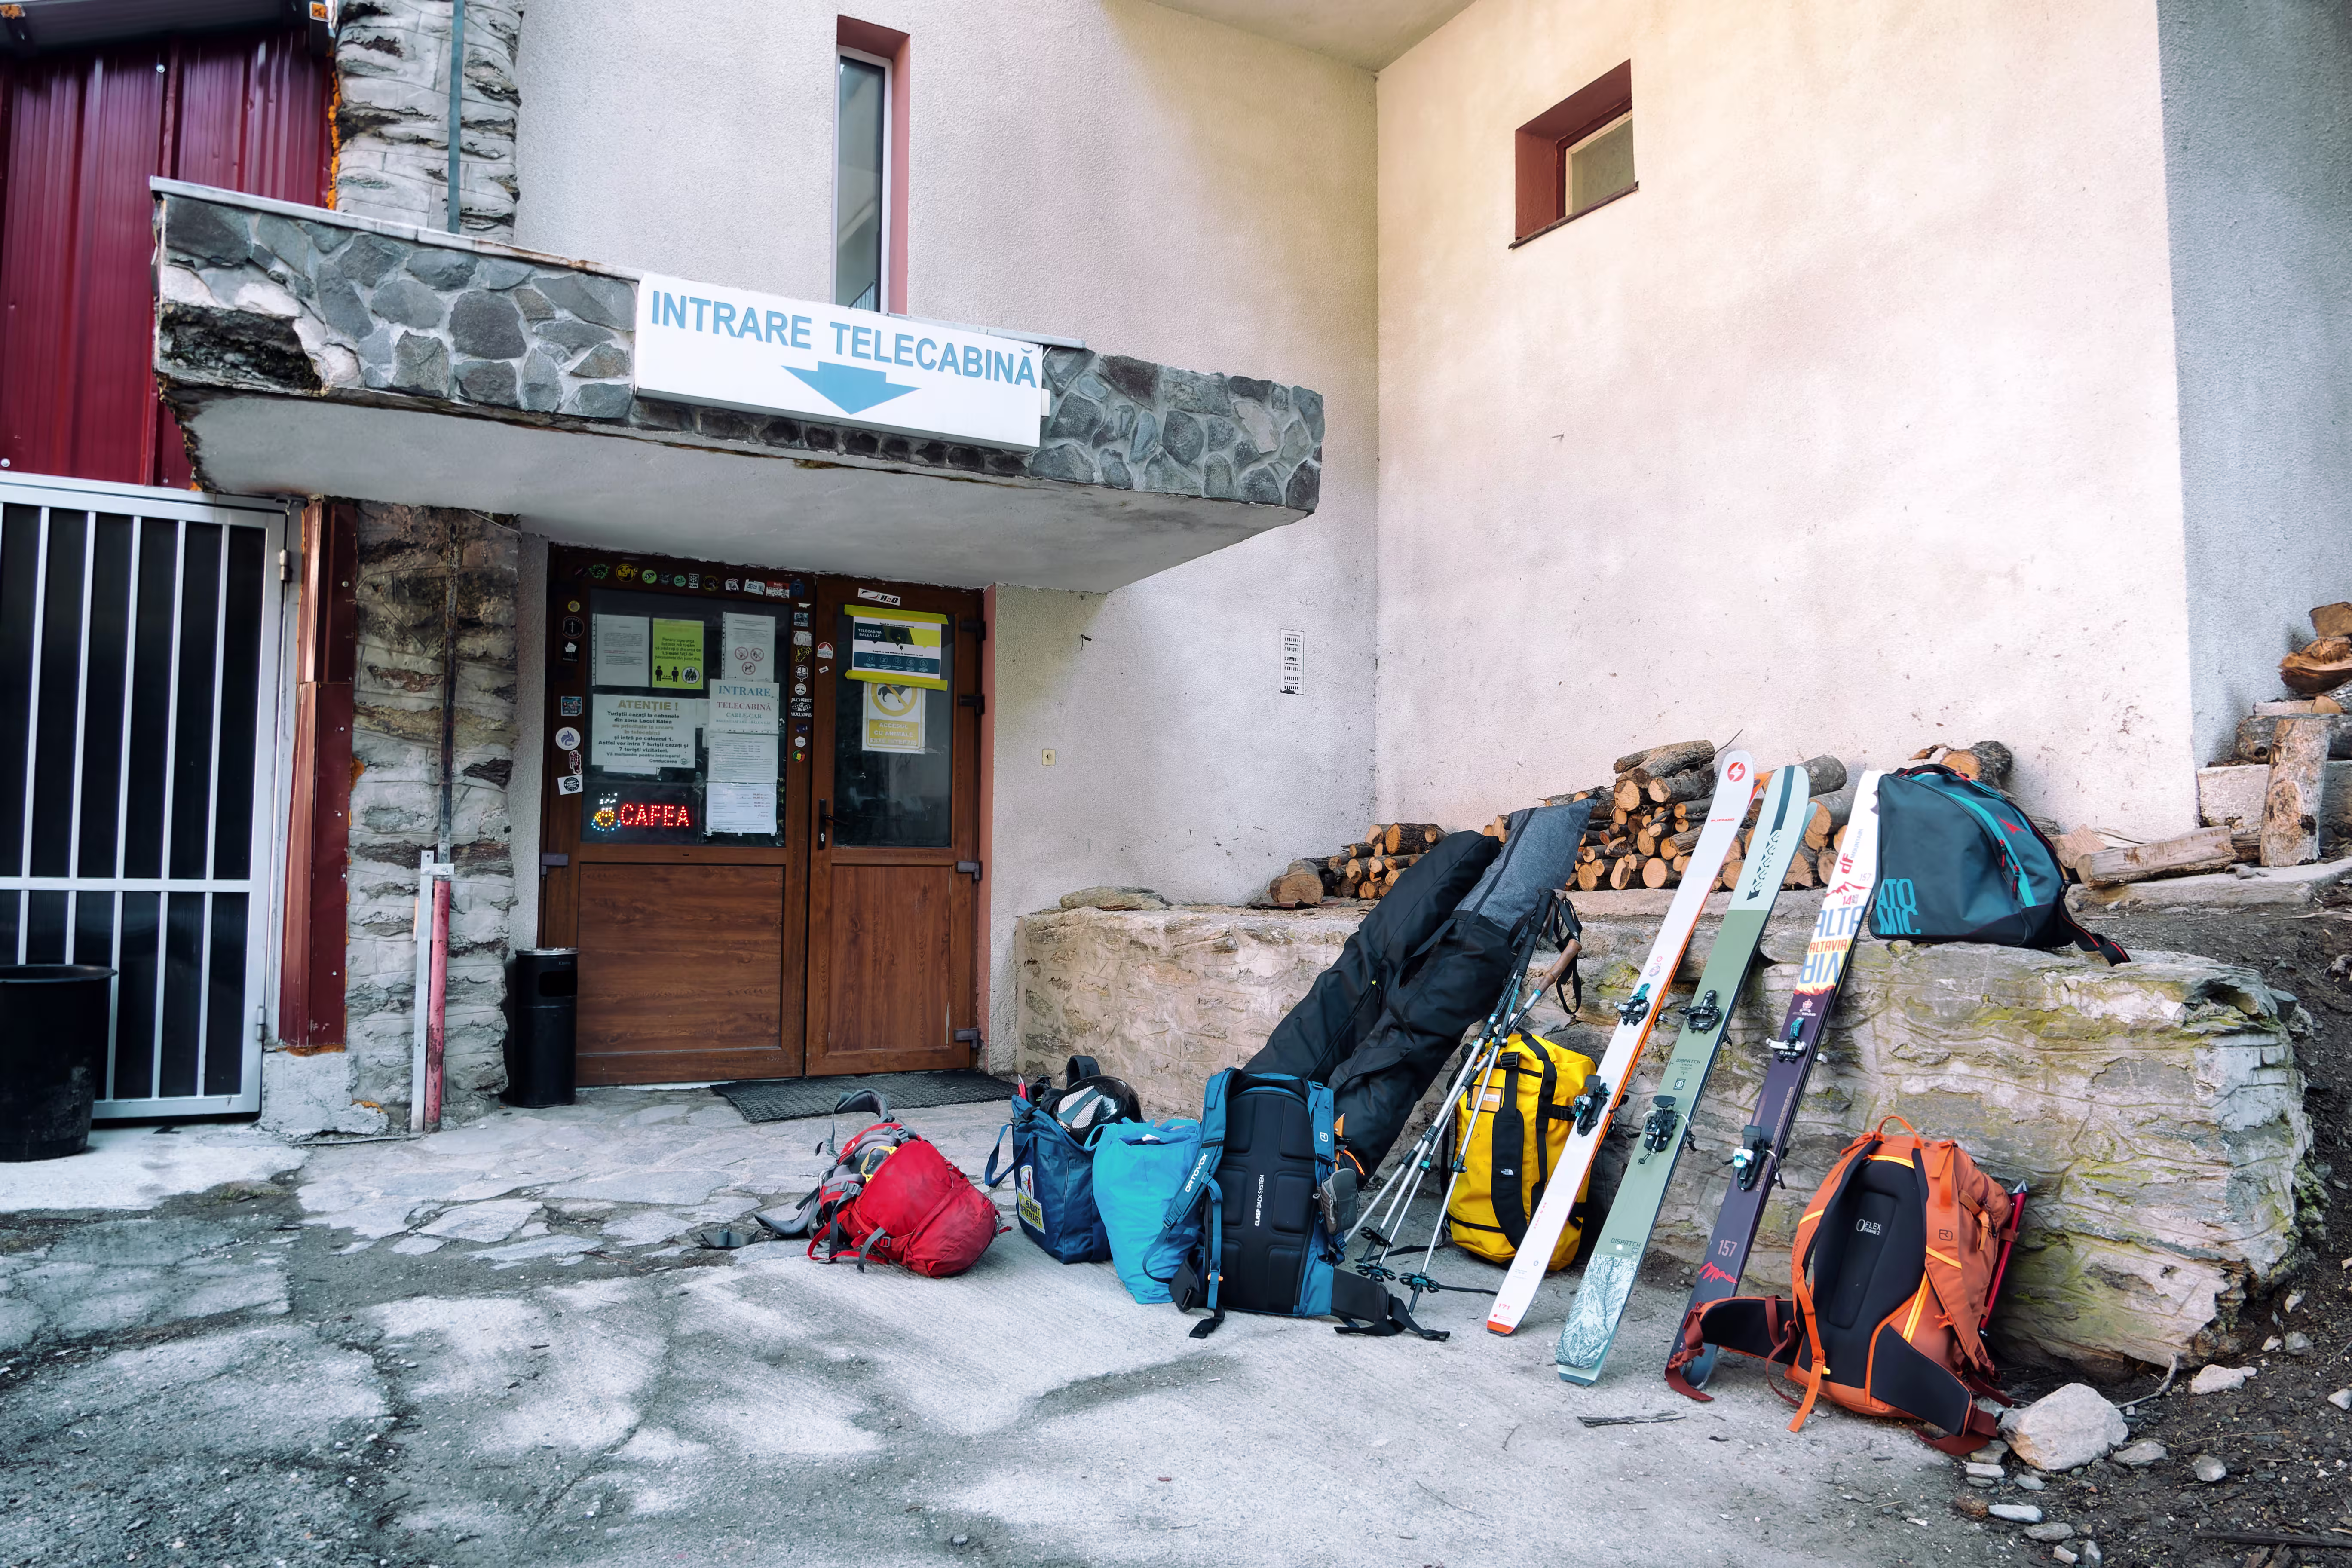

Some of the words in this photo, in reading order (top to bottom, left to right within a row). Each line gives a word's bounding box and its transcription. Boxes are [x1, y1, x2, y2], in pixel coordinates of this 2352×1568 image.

[652, 290, 812, 350] INTRARE
[830, 321, 1037, 388] TELECABINĂ
[880, 595, 898, 603] H2O
[719, 686, 771, 697] INTRARE
[717, 701, 772, 710] TELECABINĂ
[620, 803, 690, 827] CAFEA
[1850, 828, 1863, 858] MOUNTAIN
[1859, 873, 1871, 881] 157
[1843, 895, 1852, 905] 14
[1876, 878, 1917, 910] ATO
[1877, 907, 1921, 935] MIC
[1809, 939, 1847, 953] ALTAVIA
[1185, 1153, 1208, 1193] ORTOVOX
[1611, 1238, 1641, 1247] DISPATCH
[1718, 1239, 1737, 1257] 157
